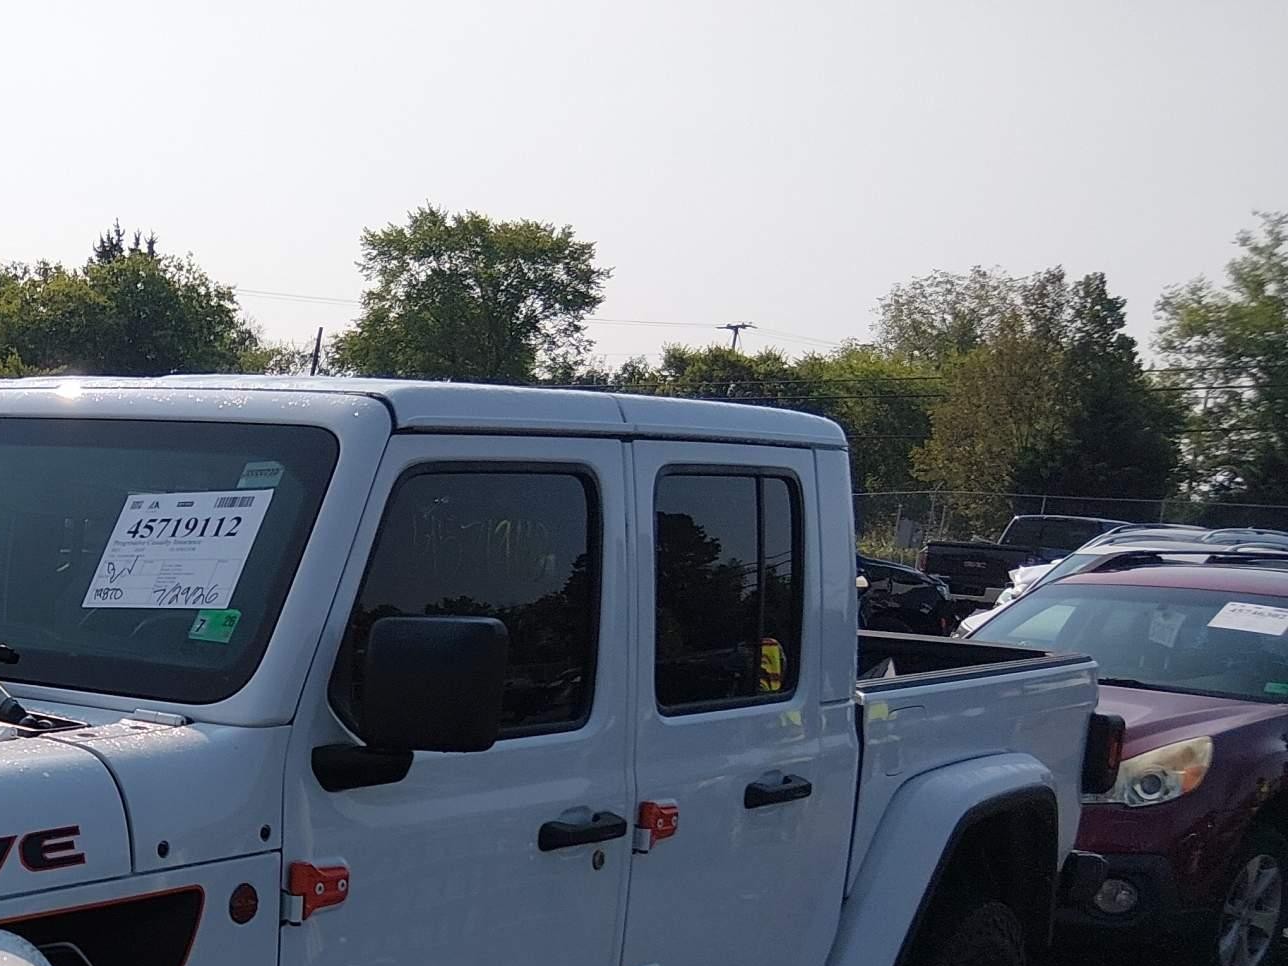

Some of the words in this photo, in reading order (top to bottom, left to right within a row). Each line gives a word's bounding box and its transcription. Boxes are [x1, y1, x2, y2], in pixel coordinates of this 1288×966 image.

[126, 515, 243, 539] 45719112
[194, 618, 207, 633] 7
[223, 615, 238, 627] 26
